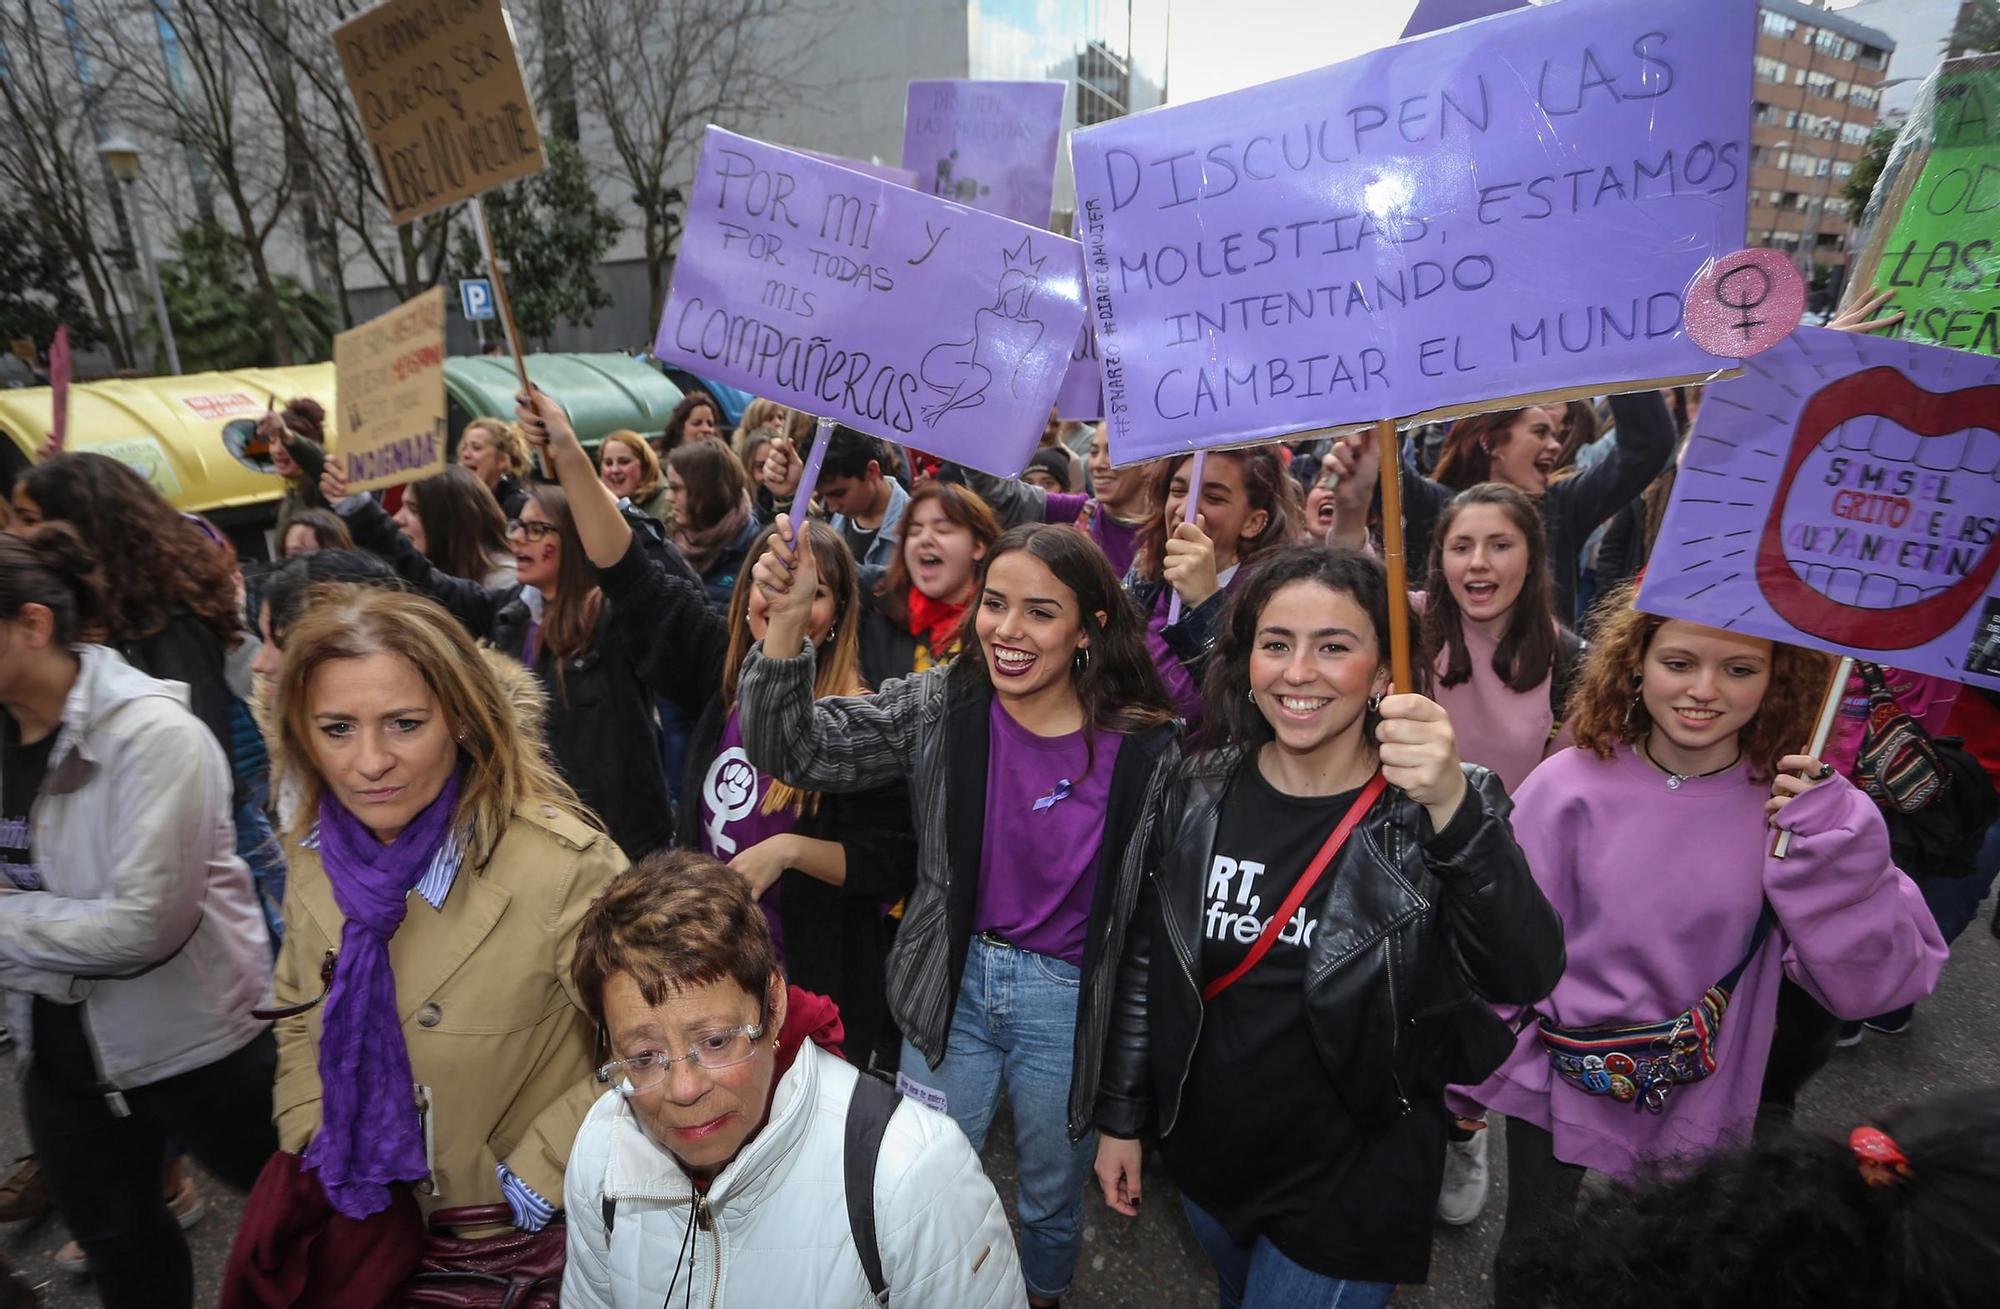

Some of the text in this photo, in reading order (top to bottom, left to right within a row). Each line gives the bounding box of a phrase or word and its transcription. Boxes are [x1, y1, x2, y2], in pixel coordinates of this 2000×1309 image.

[361, 32, 503, 131] QUIERO SER
[1105, 32, 1674, 213] DISCULPEN LAS
[716, 150, 799, 229] POR
[819, 193, 880, 249] MI
[1477, 141, 1740, 225] ESTAMOS
[717, 222, 895, 291] POR TODAS
[1889, 239, 1993, 290] LAS
[467, 285, 486, 315] P
[760, 280, 817, 318] MIS
[1165, 254, 1494, 348] INTENTANDO
[1154, 347, 1390, 420] CAMBIAR
[1418, 336, 1478, 377] EL
[1832, 489, 1911, 528] GRITO
[1206, 854, 1265, 915] RT,
